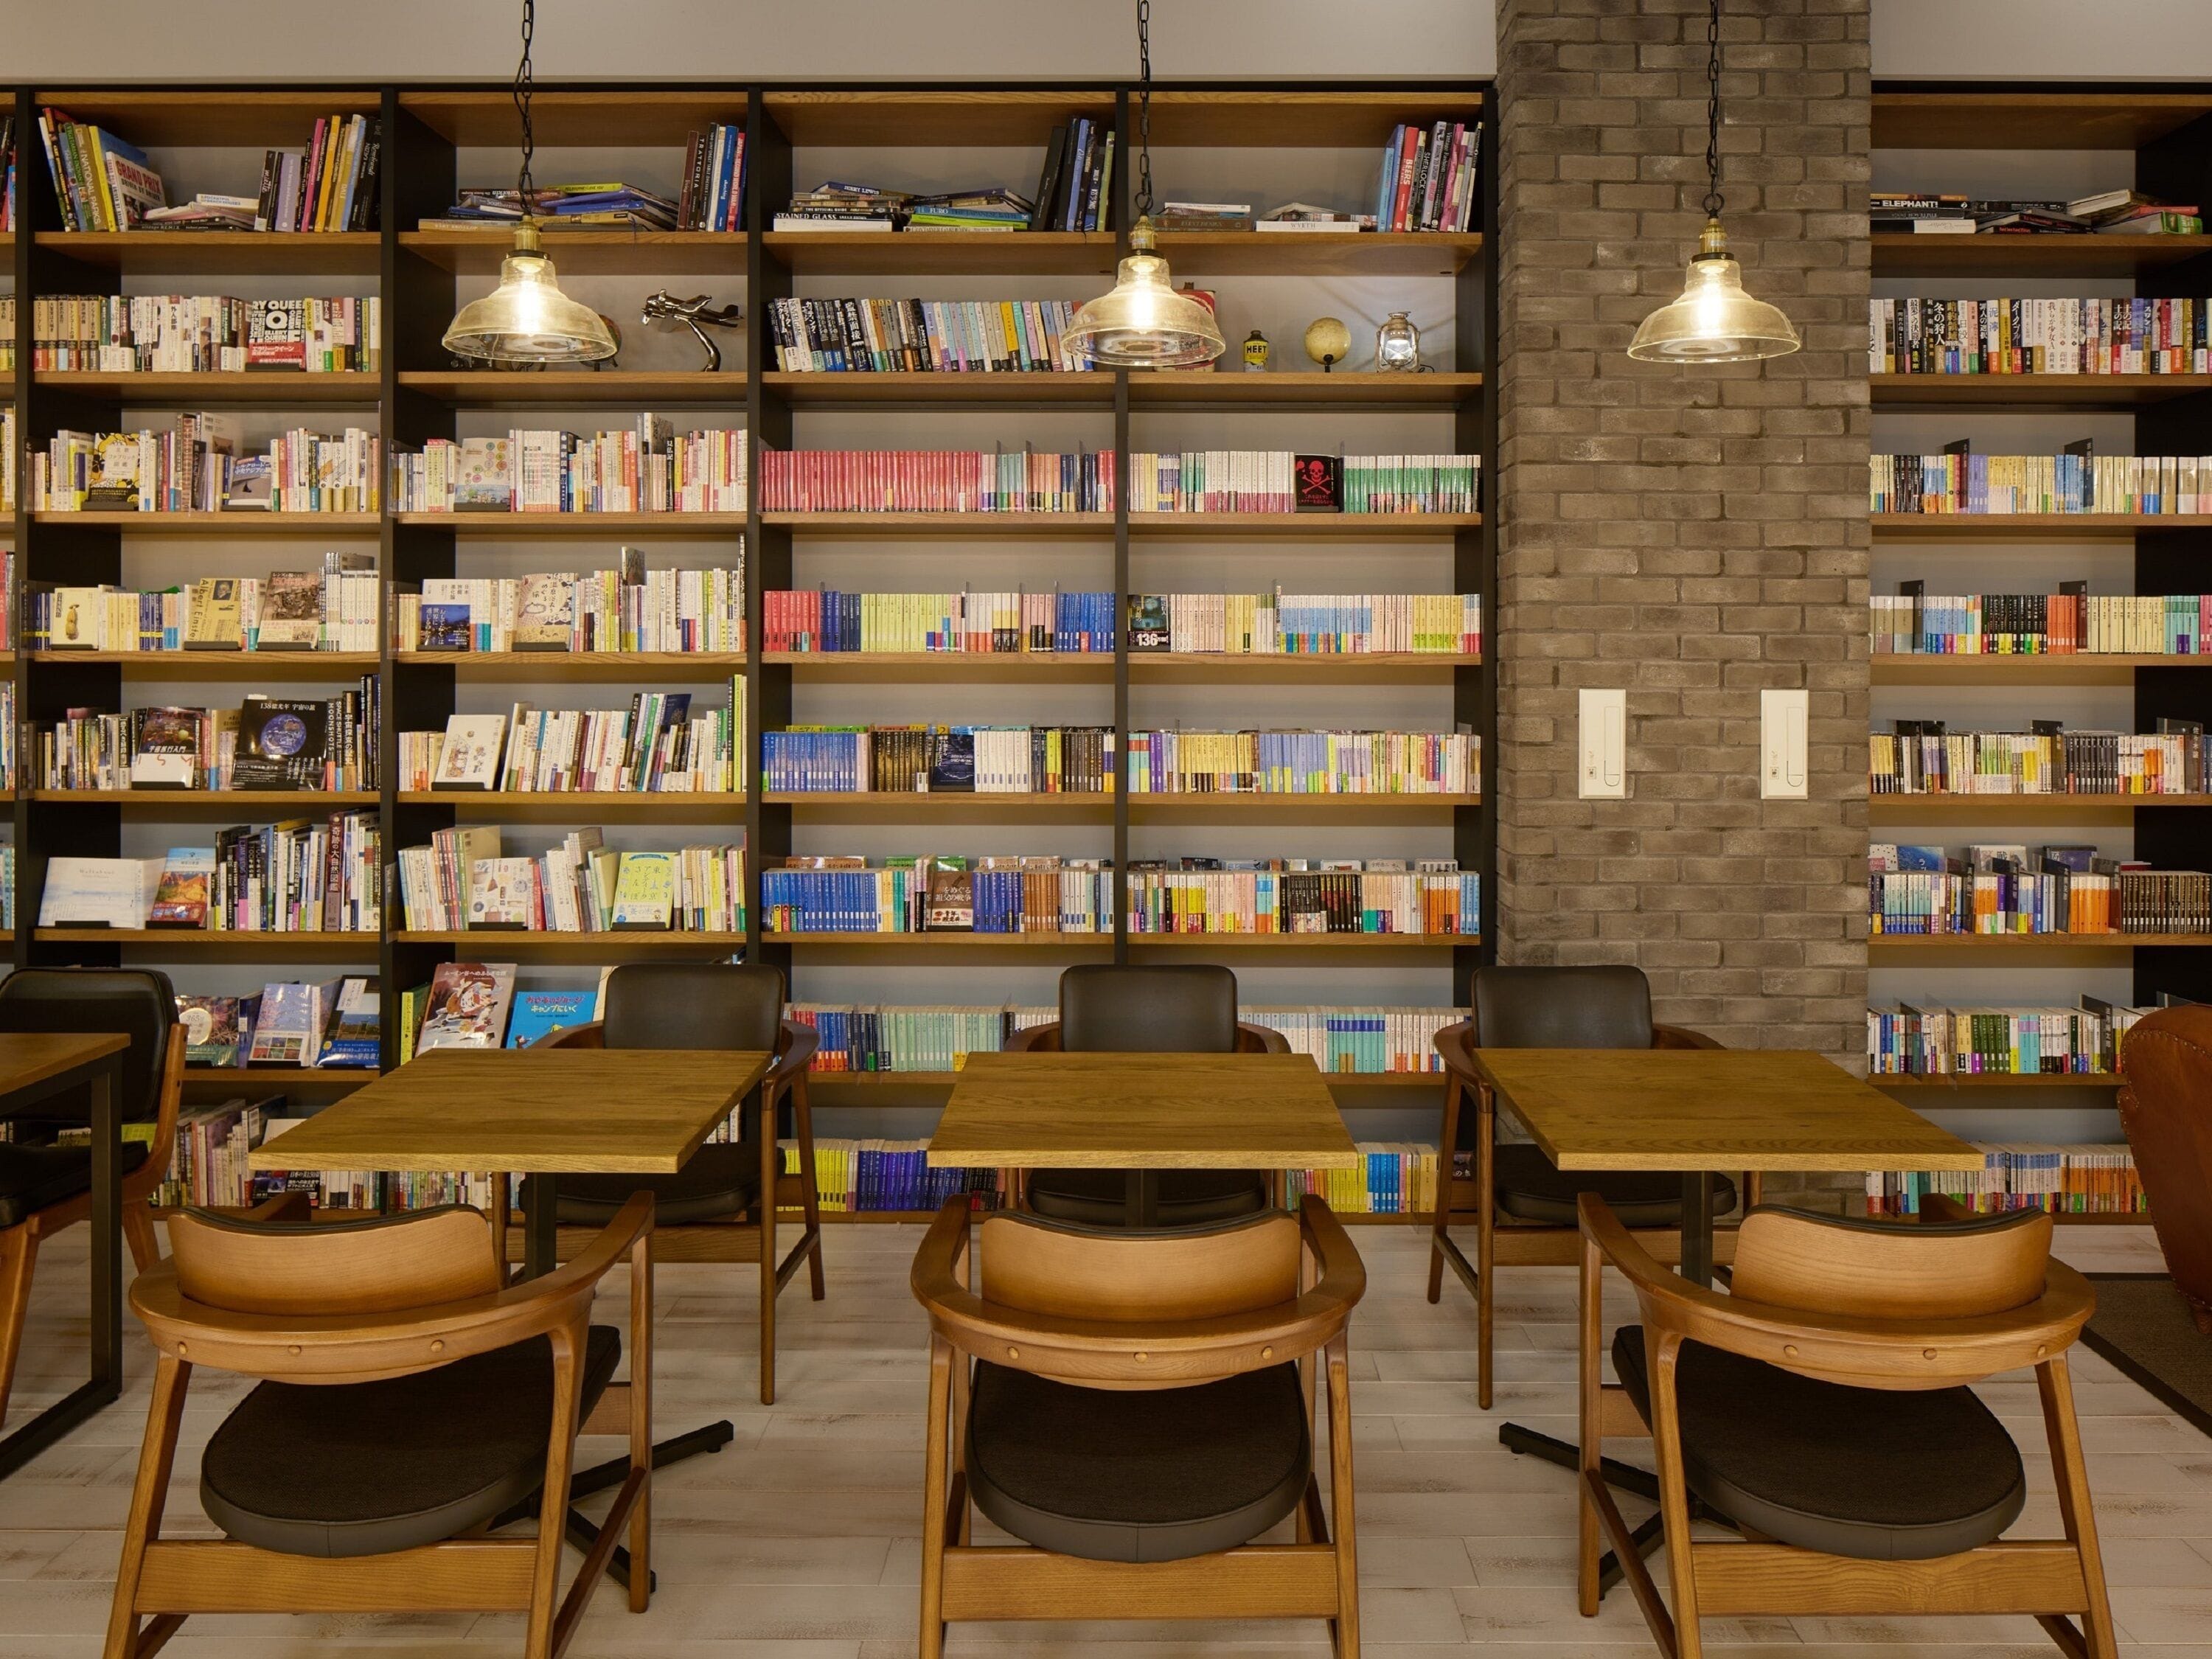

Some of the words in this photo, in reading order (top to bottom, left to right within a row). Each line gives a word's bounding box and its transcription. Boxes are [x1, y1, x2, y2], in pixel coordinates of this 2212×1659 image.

[1444, 131, 1453, 152] Vintage
[368, 143, 380, 176] Rembrandt
[694, 138, 705, 189] TRATTORIA
[1403, 159, 1413, 185] BEERS
[1419, 152, 1431, 189] SHERLOCK
[1440, 153, 1449, 173] Fashion
[81, 151, 94, 195] NATIONAL
[89, 195, 101, 224] PARKS
[116, 161, 142, 185] GRAND
[142, 171, 161, 194] PRIX
[121, 180, 138, 194] DRIVER
[1882, 200, 1938, 208] ELEPHANT!
[1934, 302, 1946, 346] 冬の狩人
[1246, 345, 1267, 353] HEET
[196, 579, 209, 608] Albert
[330, 827, 340, 892] 奇跡の大自然図鑑
[526, 995, 585, 1004] おさるのジョージ
[531, 1004, 578, 1014] キャンプにいく
